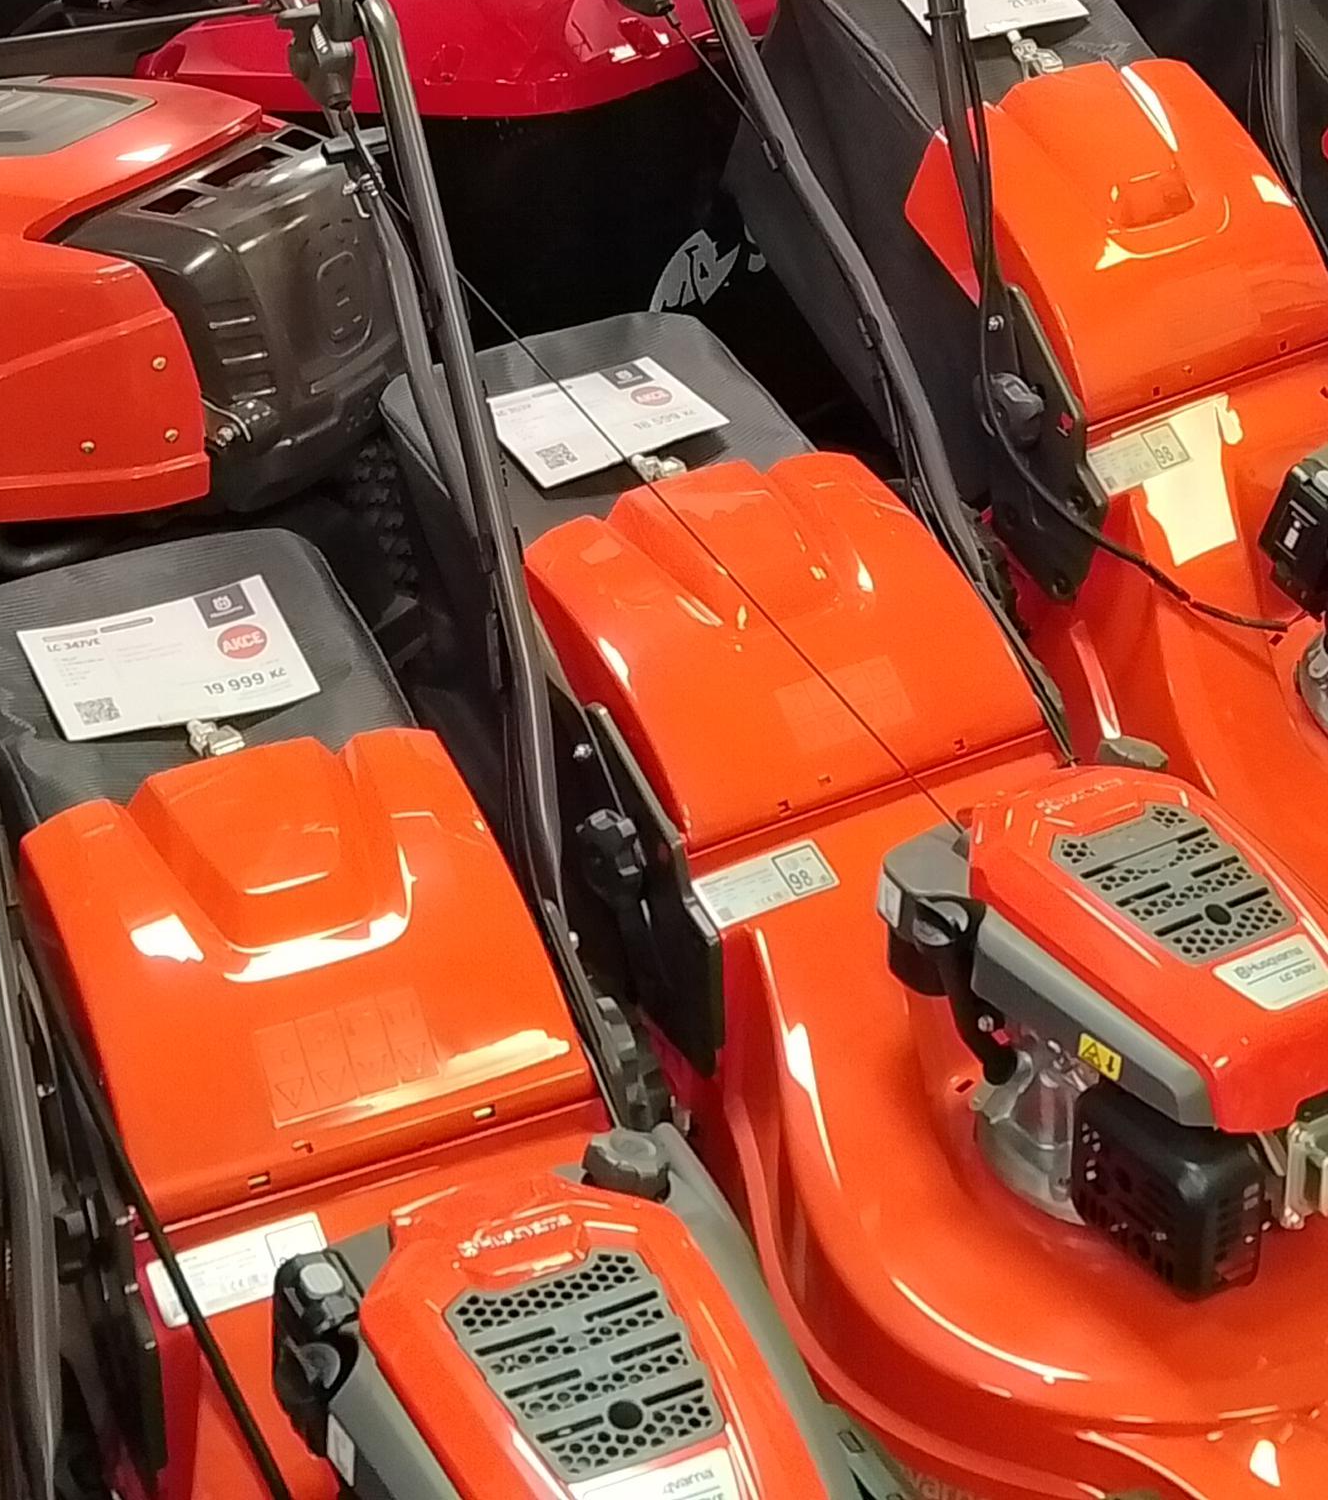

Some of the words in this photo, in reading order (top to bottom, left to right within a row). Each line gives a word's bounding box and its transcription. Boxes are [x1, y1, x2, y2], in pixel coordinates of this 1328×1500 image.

[222, 629, 265, 653] AKCE
[204, 682, 225, 696] 19
[227, 671, 265, 692] 999
[270, 666, 287, 679] Kč
[788, 869, 814, 890] 98
[662, 1467, 716, 1495] qvarna
